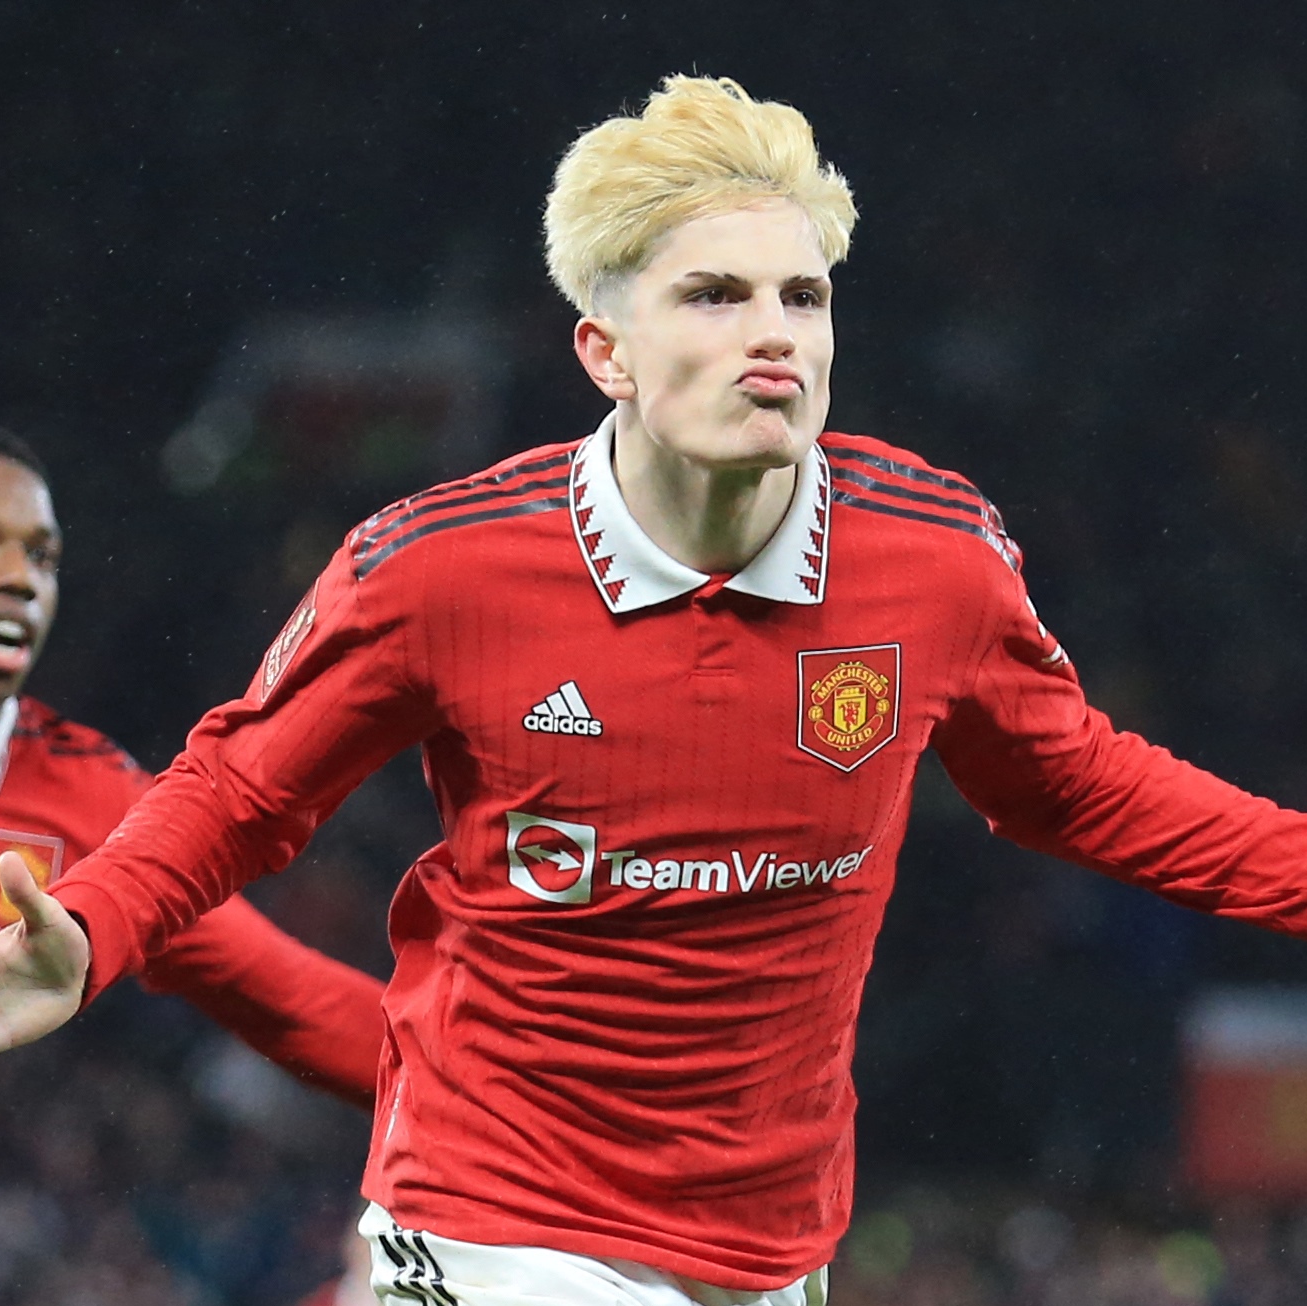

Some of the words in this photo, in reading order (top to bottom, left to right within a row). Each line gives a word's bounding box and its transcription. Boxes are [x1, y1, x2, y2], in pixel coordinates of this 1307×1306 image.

[817, 667, 883, 699] MANCHESTER
[523, 713, 602, 736] adidas
[827, 727, 873, 745] UNITED
[600, 844, 873, 893] TeamViewer
